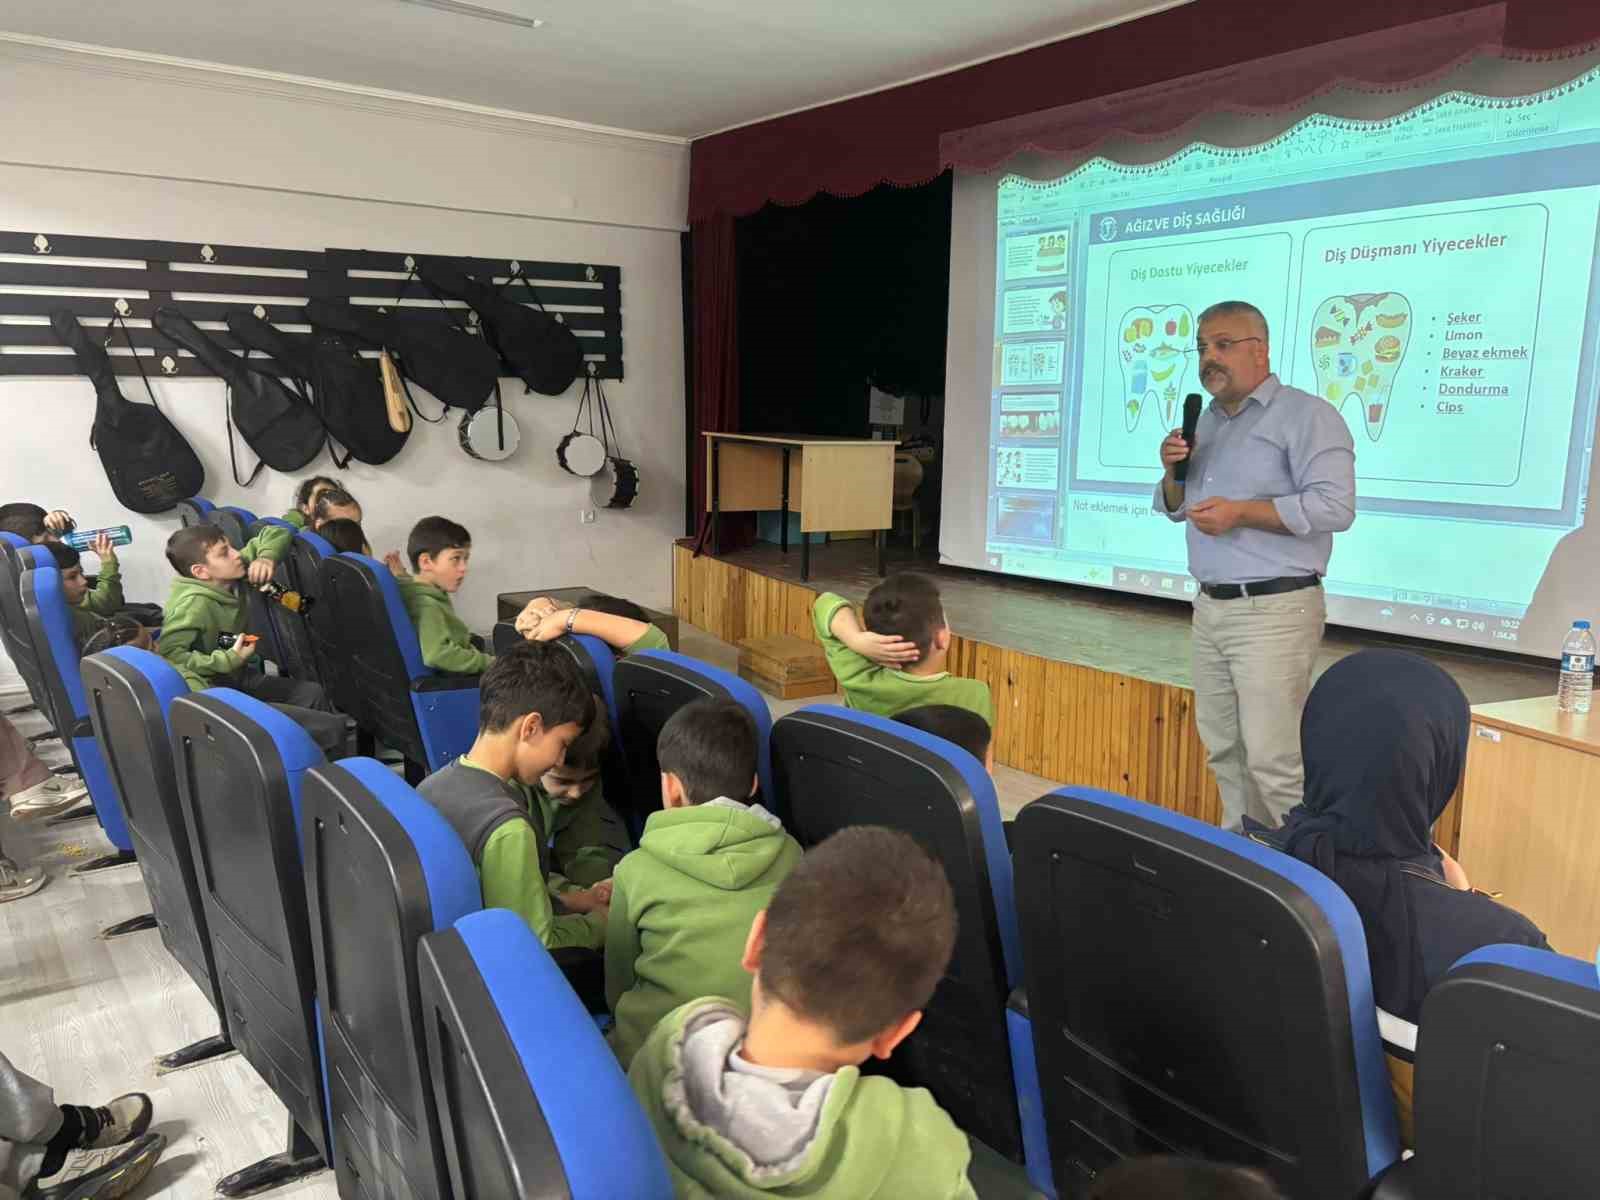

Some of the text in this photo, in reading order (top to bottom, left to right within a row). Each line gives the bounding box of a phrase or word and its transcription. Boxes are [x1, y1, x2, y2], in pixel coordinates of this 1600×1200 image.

[1173, 211, 1193, 229] DİŞ
[1195, 204, 1246, 225] SAĞLIĞI
[1325, 233, 1508, 264] Diş Düşmanı Yiyecekler
[1130, 258, 1249, 282] Diş Dostu Yiyecekler
[1447, 312, 1482, 326] Şeker
[1445, 330, 1483, 341] Limon
[1442, 346, 1528, 360] Beyaz ekmek
[1440, 365, 1485, 379] Kraker
[1439, 383, 1509, 397] Dondurma
[1437, 401, 1464, 414] Cips
